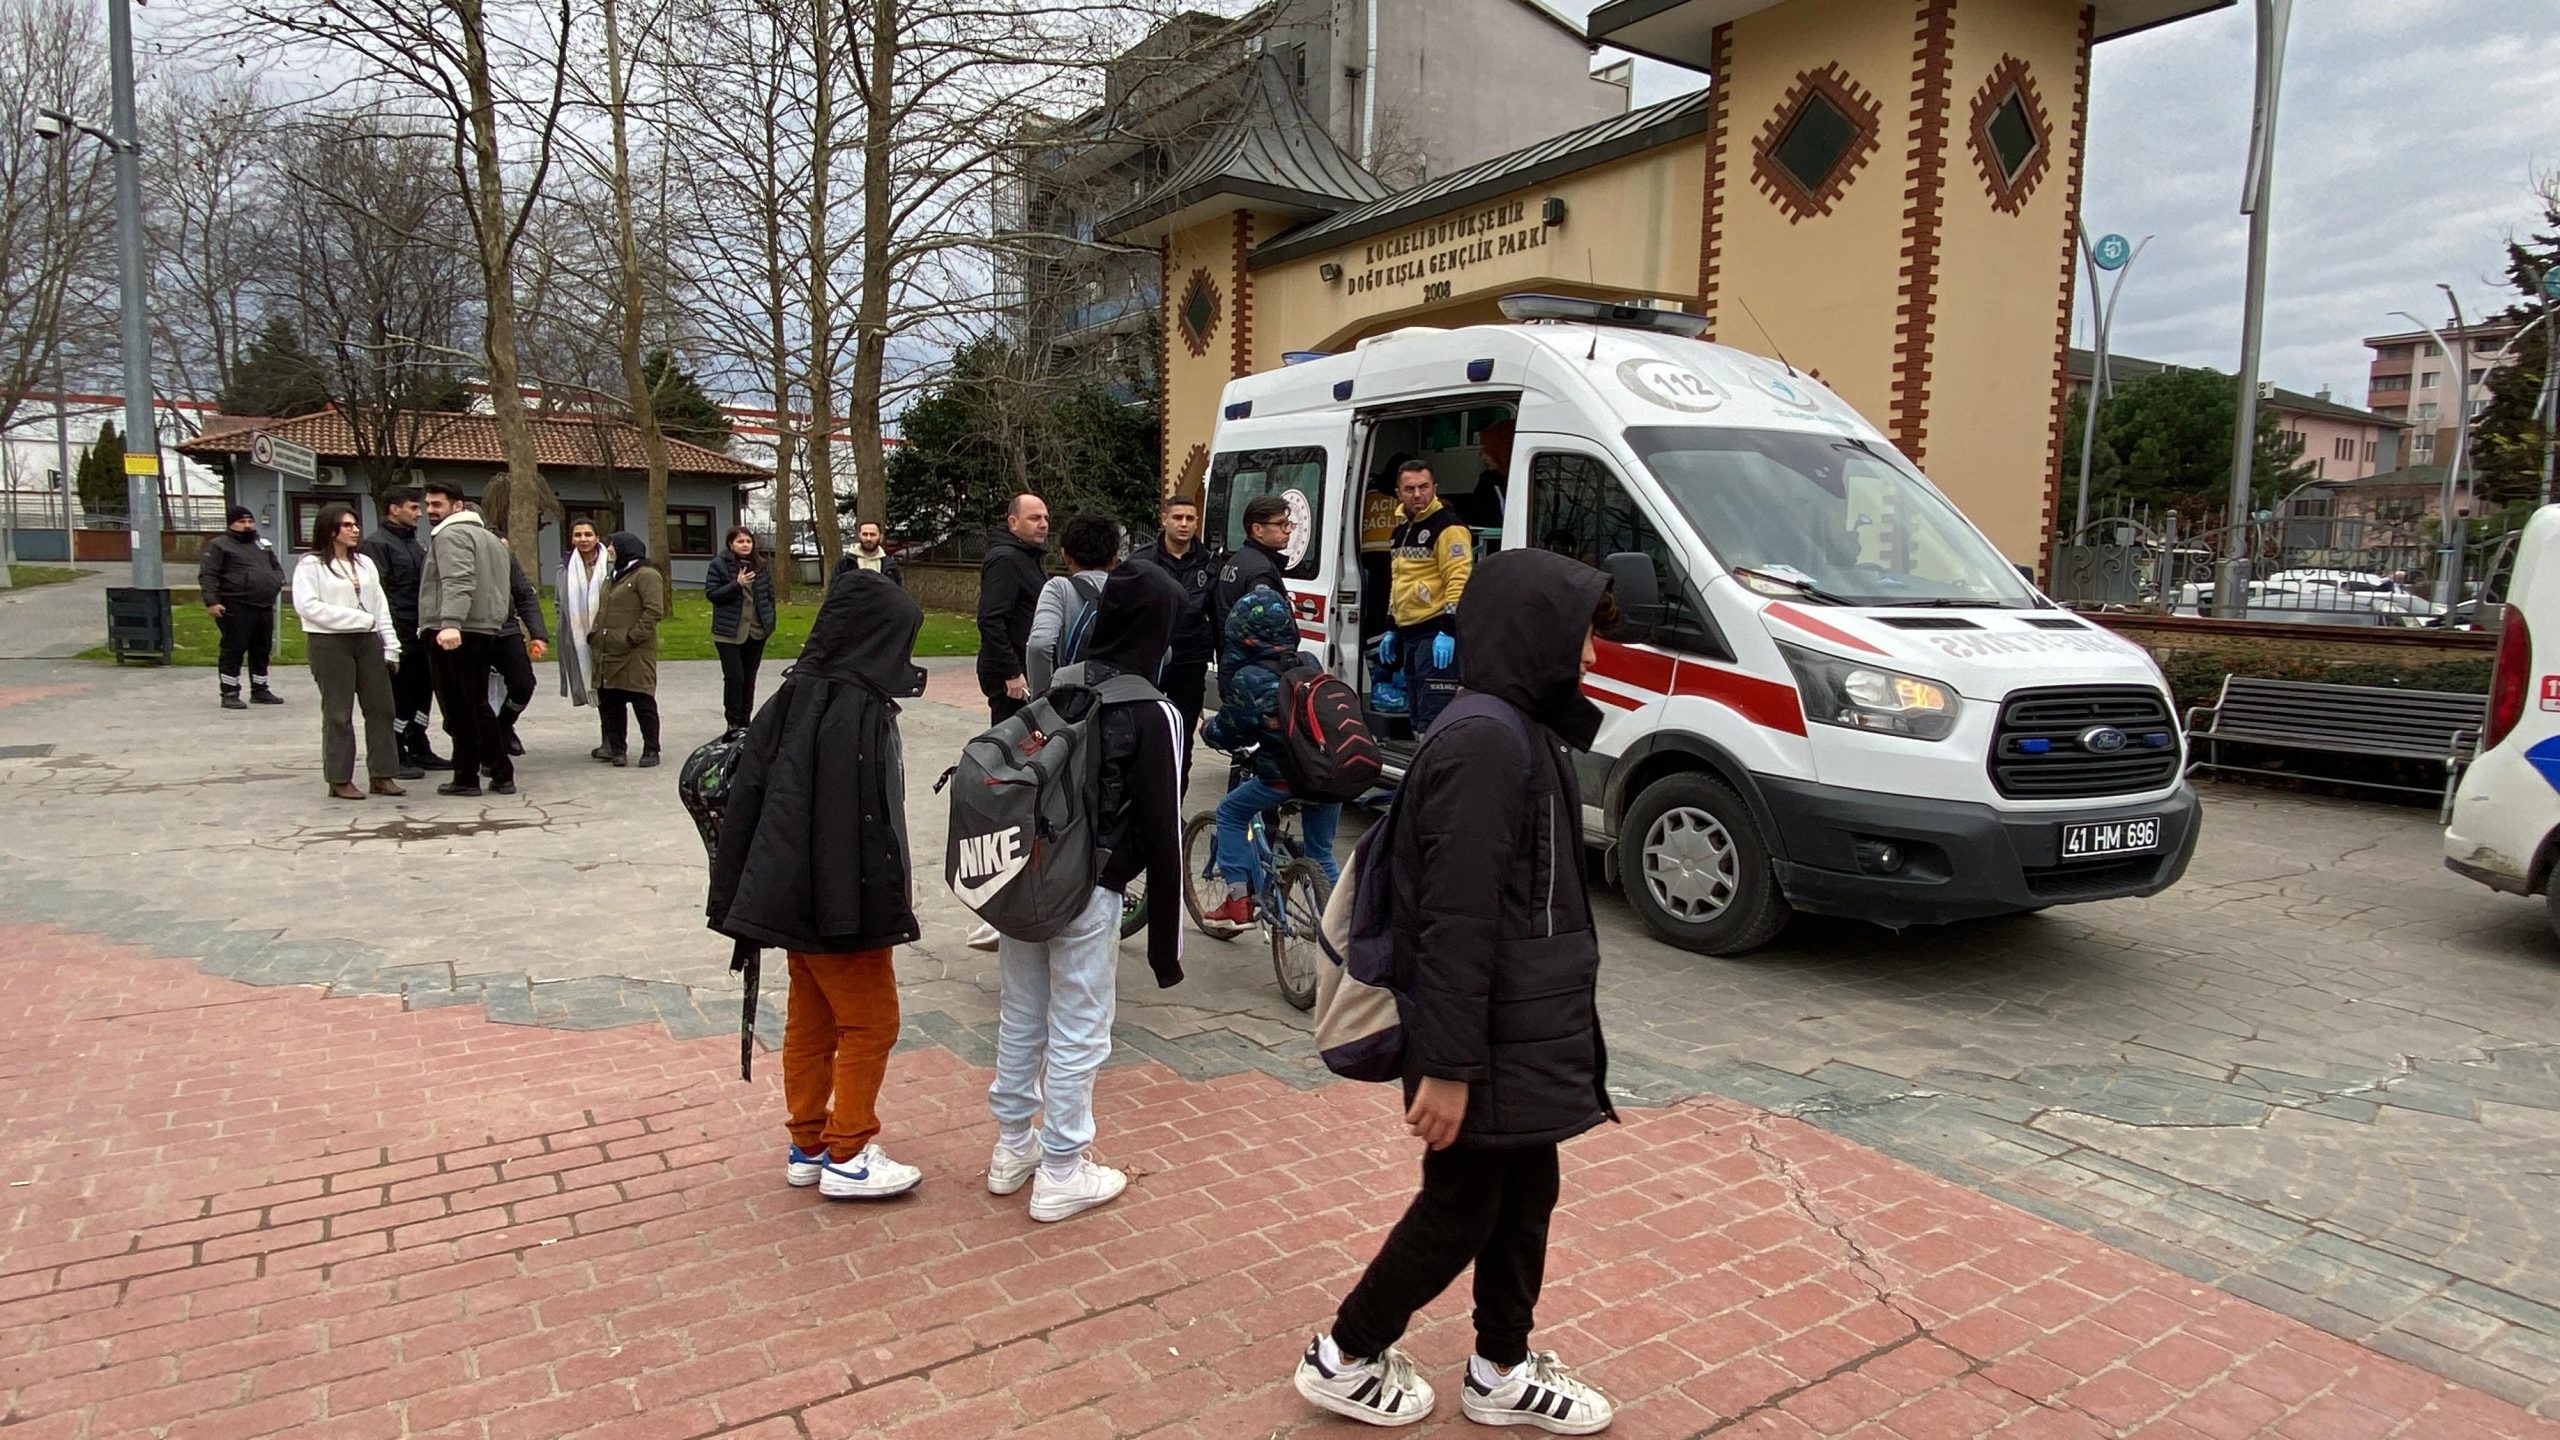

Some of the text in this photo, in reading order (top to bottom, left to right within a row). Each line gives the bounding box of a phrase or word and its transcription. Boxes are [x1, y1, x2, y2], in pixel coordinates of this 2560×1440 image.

[1366, 200, 1524, 265] KOCAELİ BÜYÜKŞEHİR
[1348, 222, 1548, 296] DOĞU KIŞLA GENÇLİK PARKI
[1423, 280, 1451, 303] 2008
[1654, 373, 1714, 396] 112
[1363, 513, 1400, 532] SAĞLI
[2547, 680, 2560, 697] 1
[2096, 732, 2121, 749] Ford
[2069, 821, 2154, 852] 41 HM 696
[959, 826, 1023, 879] NIKE
